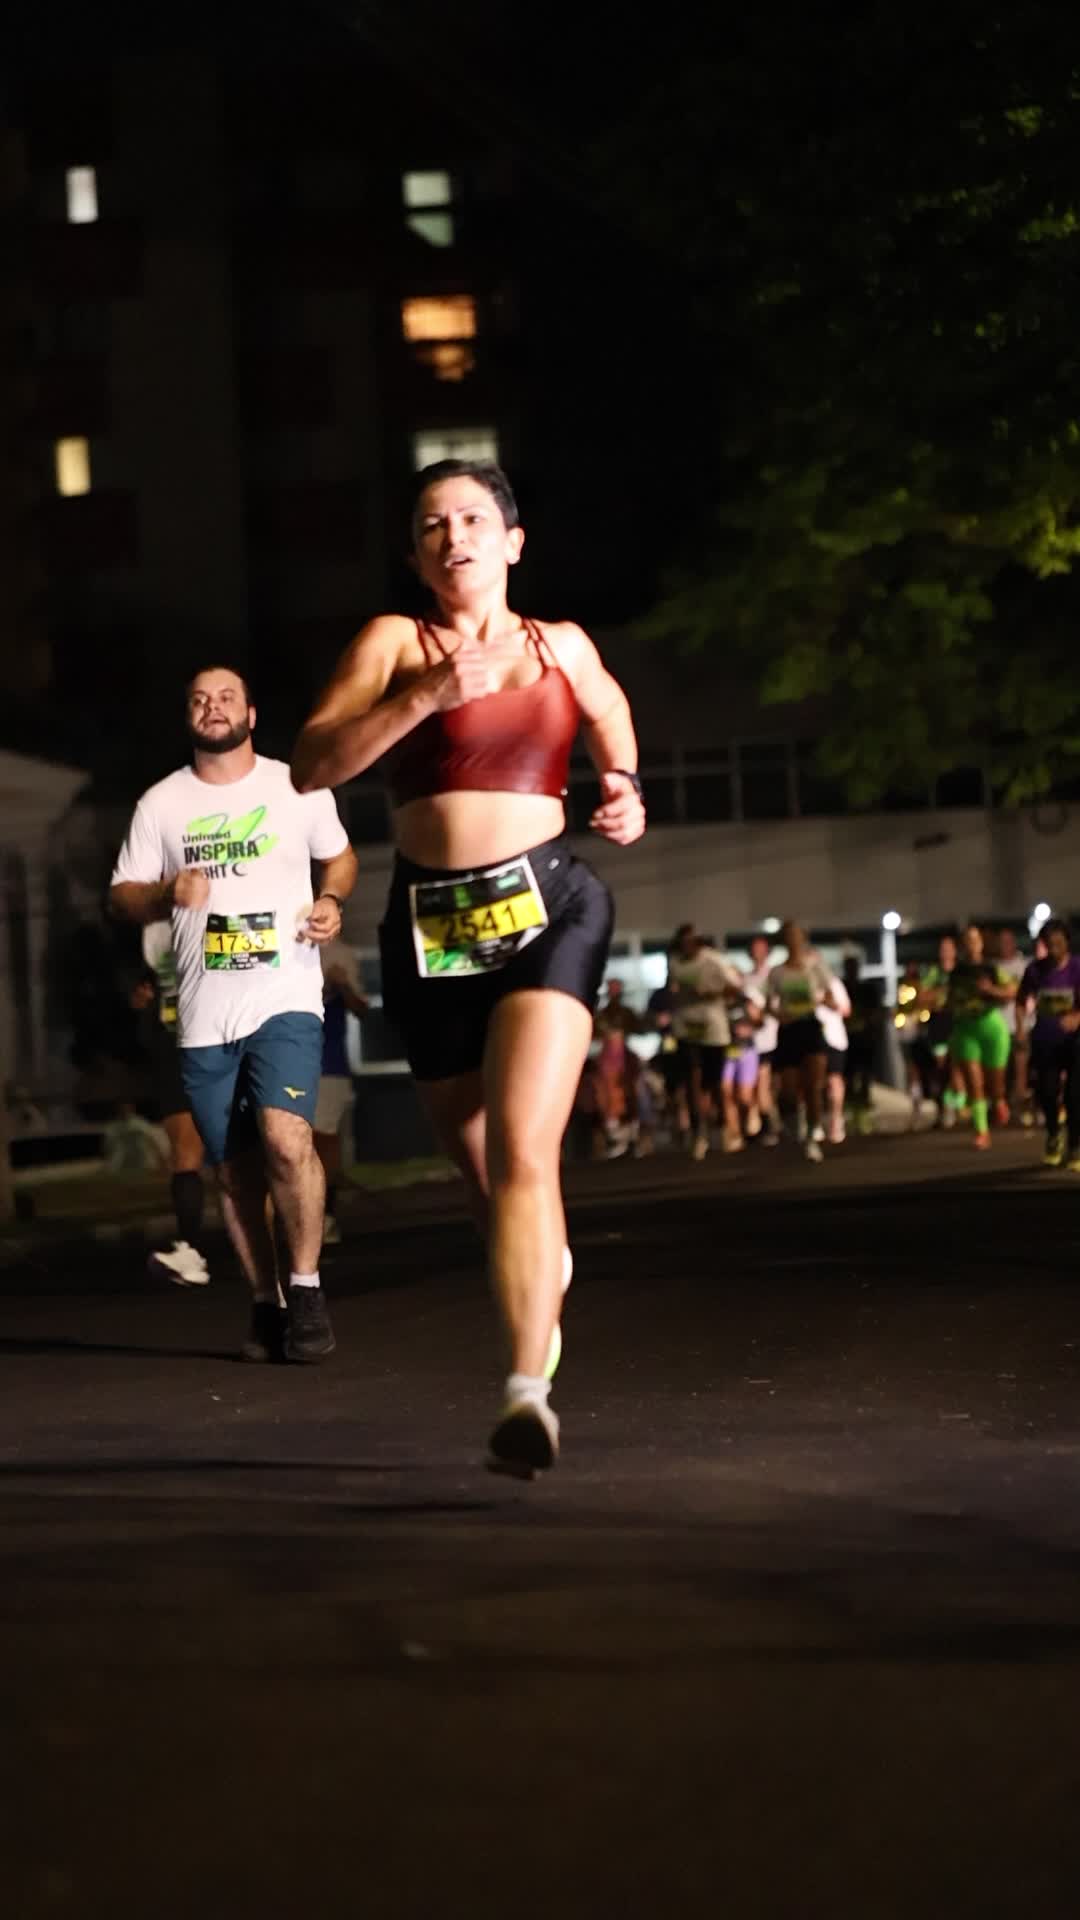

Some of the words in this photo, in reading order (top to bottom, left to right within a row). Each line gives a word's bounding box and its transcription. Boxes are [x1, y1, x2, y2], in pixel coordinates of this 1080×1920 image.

[182, 830, 231, 844] Unimed
[184, 840, 260, 865] INSPIRA
[442, 904, 517, 943] 2541
[216, 932, 265, 952] 1735
